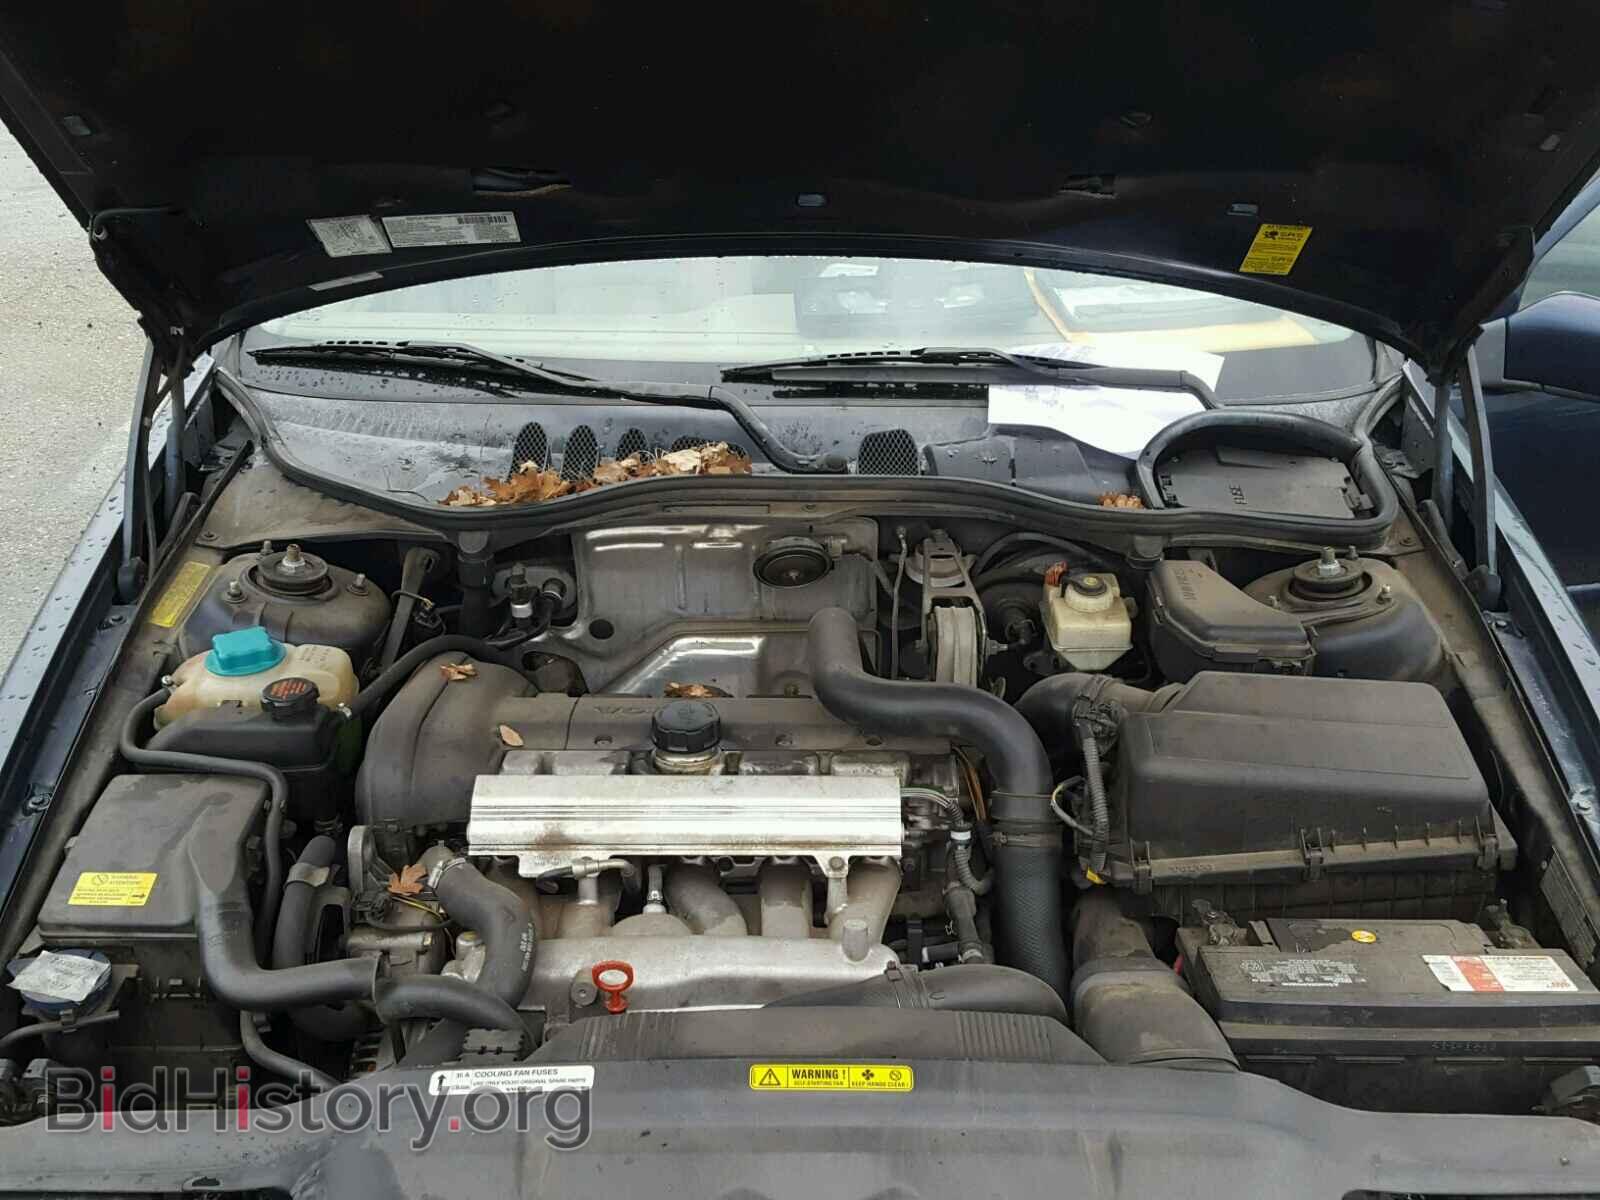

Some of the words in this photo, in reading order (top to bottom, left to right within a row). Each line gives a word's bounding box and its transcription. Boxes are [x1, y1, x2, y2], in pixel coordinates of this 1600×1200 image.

[474, 1070, 512, 1079] COOLING
[532, 1068, 558, 1076] FUSES
[791, 1069, 839, 1080] WARNING
